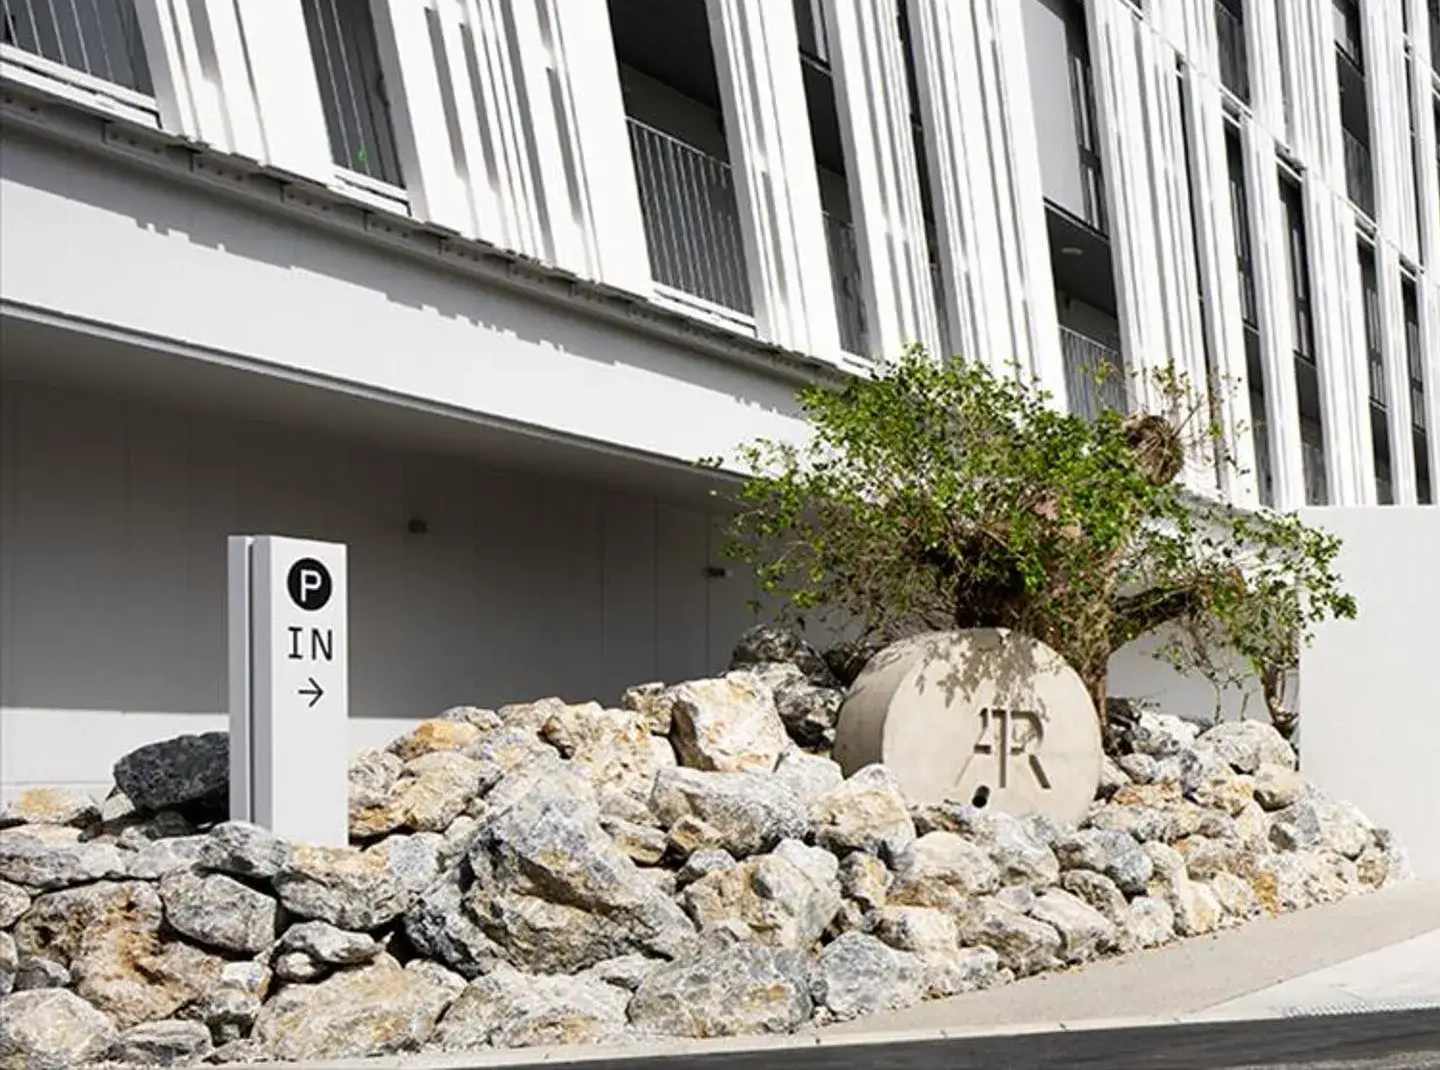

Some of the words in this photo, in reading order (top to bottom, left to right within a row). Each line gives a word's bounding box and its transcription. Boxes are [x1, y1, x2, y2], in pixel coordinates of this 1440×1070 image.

[300, 568, 322, 603] P
[287, 626, 333, 661] IN
[954, 707, 1051, 789] AR
